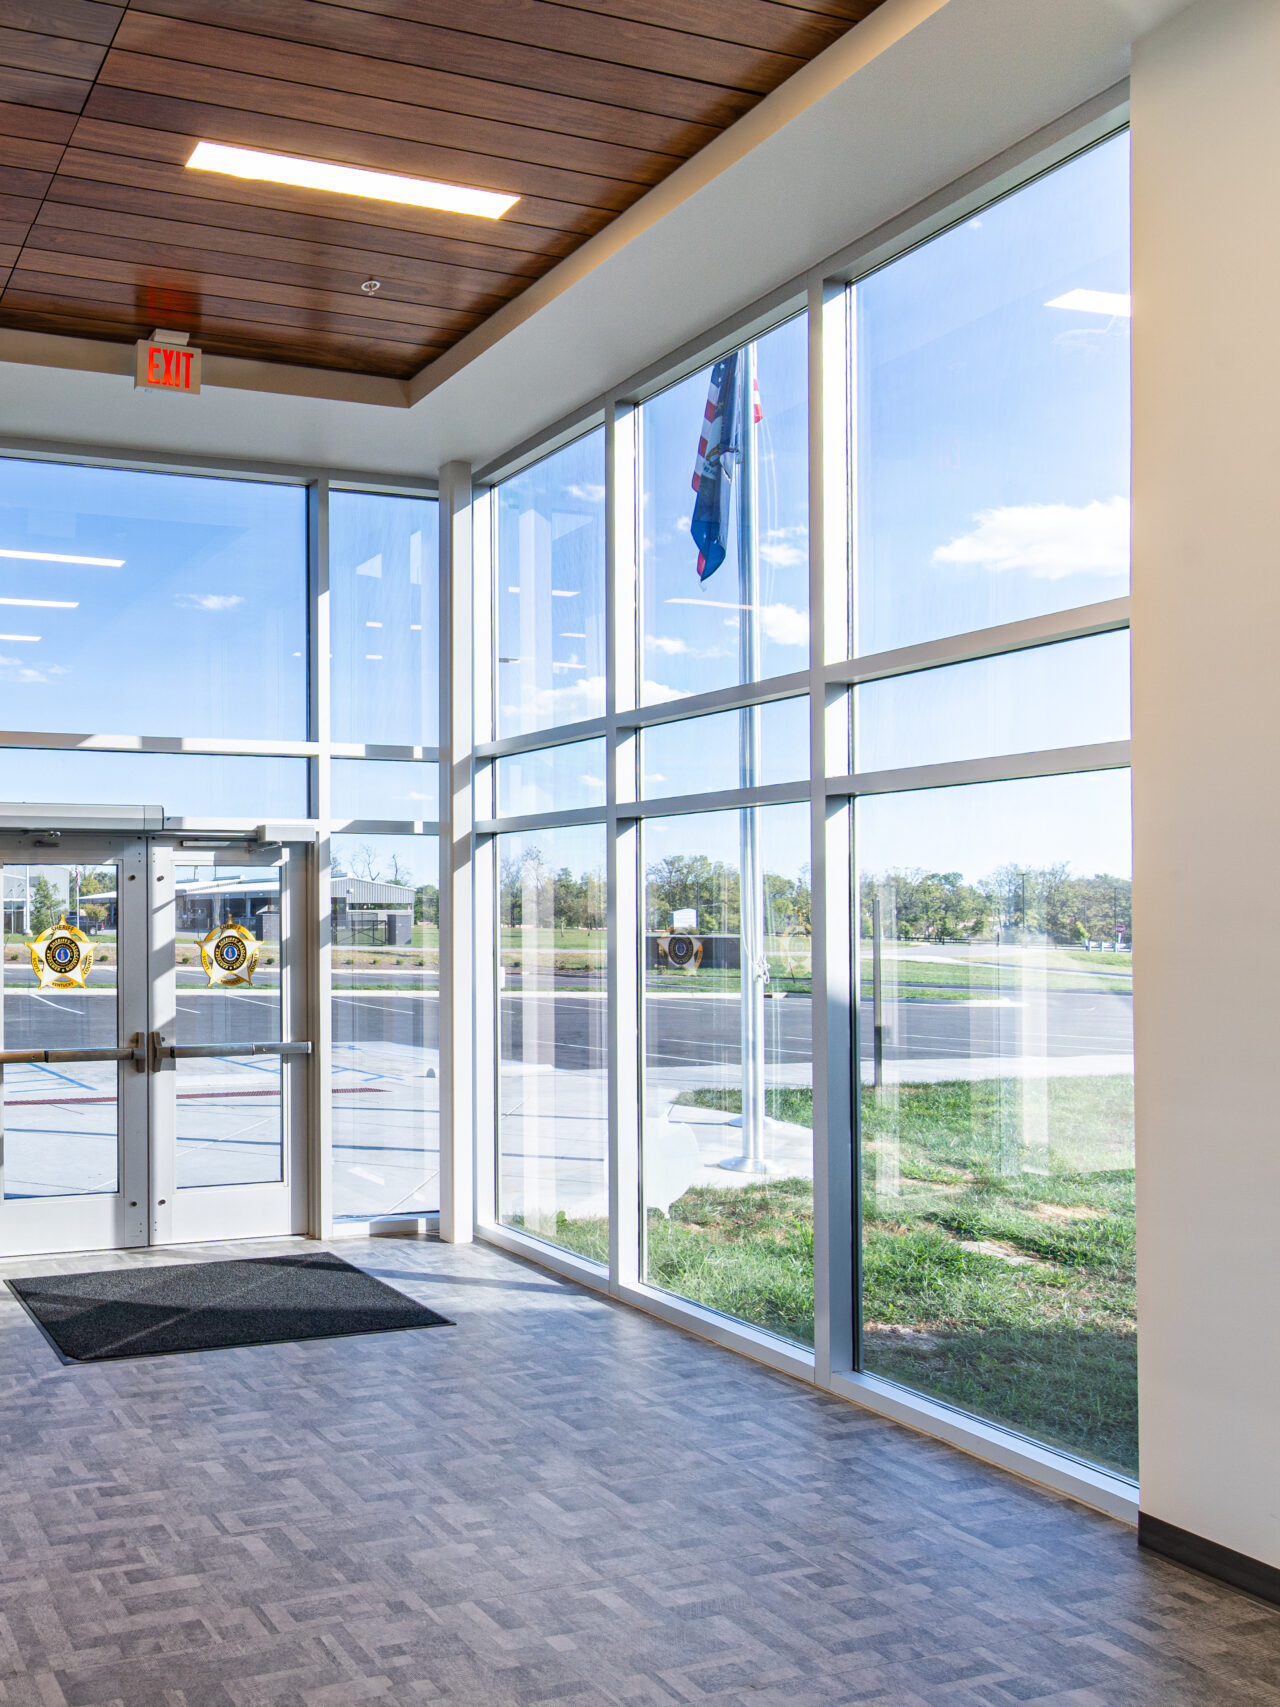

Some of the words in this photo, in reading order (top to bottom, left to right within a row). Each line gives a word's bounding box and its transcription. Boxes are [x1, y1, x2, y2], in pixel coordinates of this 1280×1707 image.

[147, 346, 195, 389] EXIT
[32, 957, 40, 973] SCOTT
[83, 955, 93, 975] COUNTY
[202, 956, 210, 970] SCOTT
